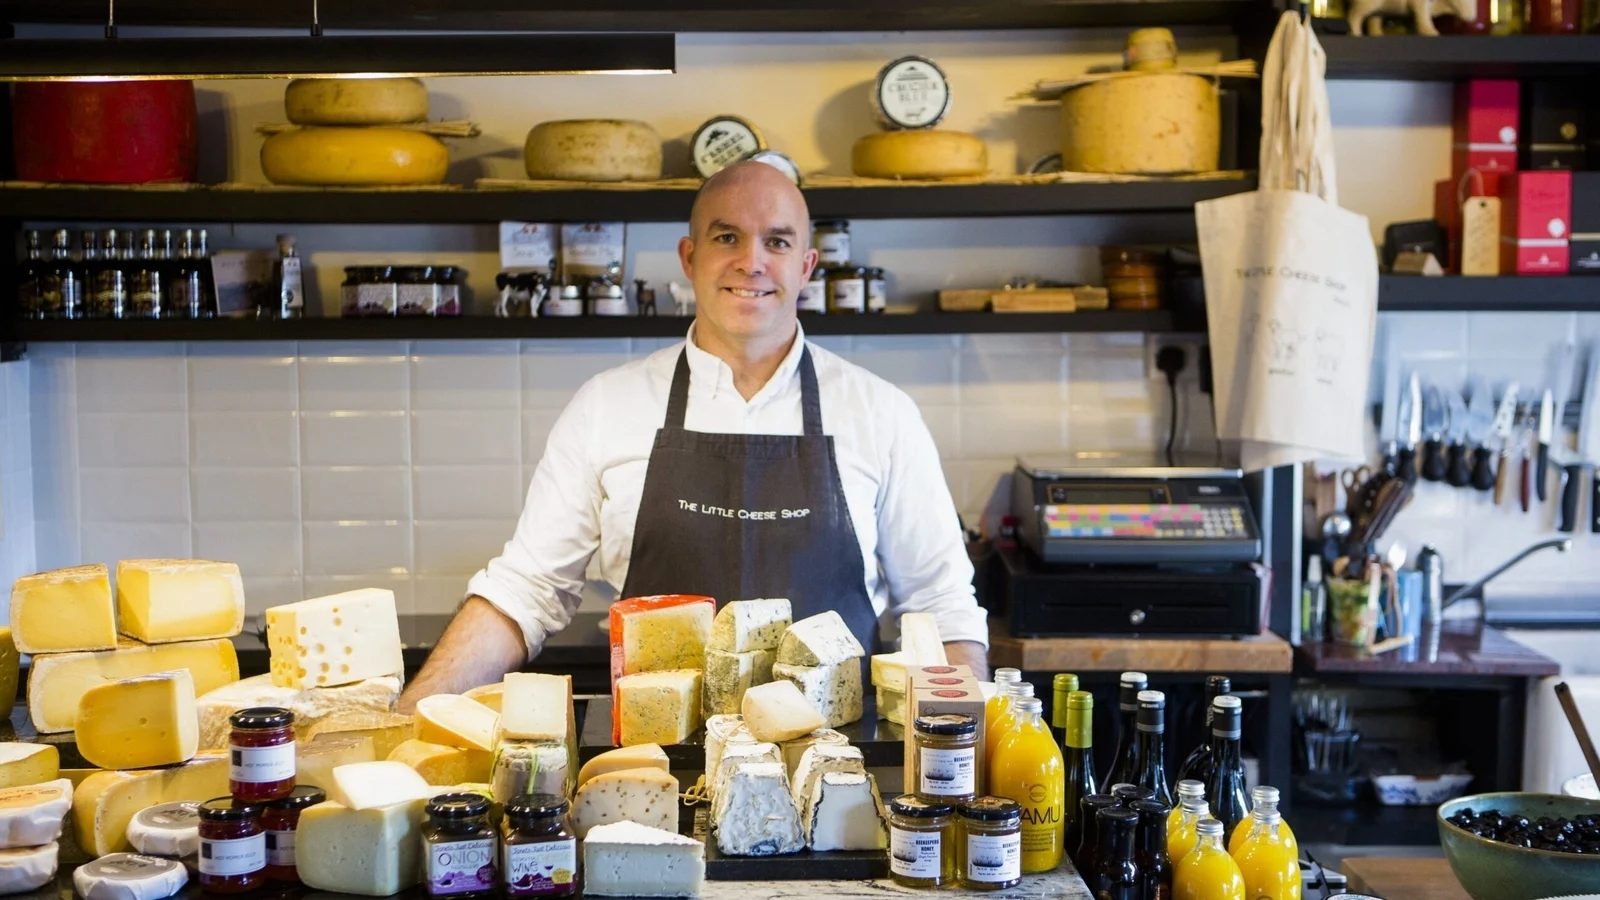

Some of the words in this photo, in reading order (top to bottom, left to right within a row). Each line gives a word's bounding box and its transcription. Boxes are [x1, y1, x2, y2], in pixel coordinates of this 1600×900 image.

[678, 499, 698, 512] THE
[701, 504, 735, 518] LITTLE
[737, 509, 777, 521] CHEESE
[781, 508, 811, 519] SHOP
[438, 848, 491, 867] ONION
